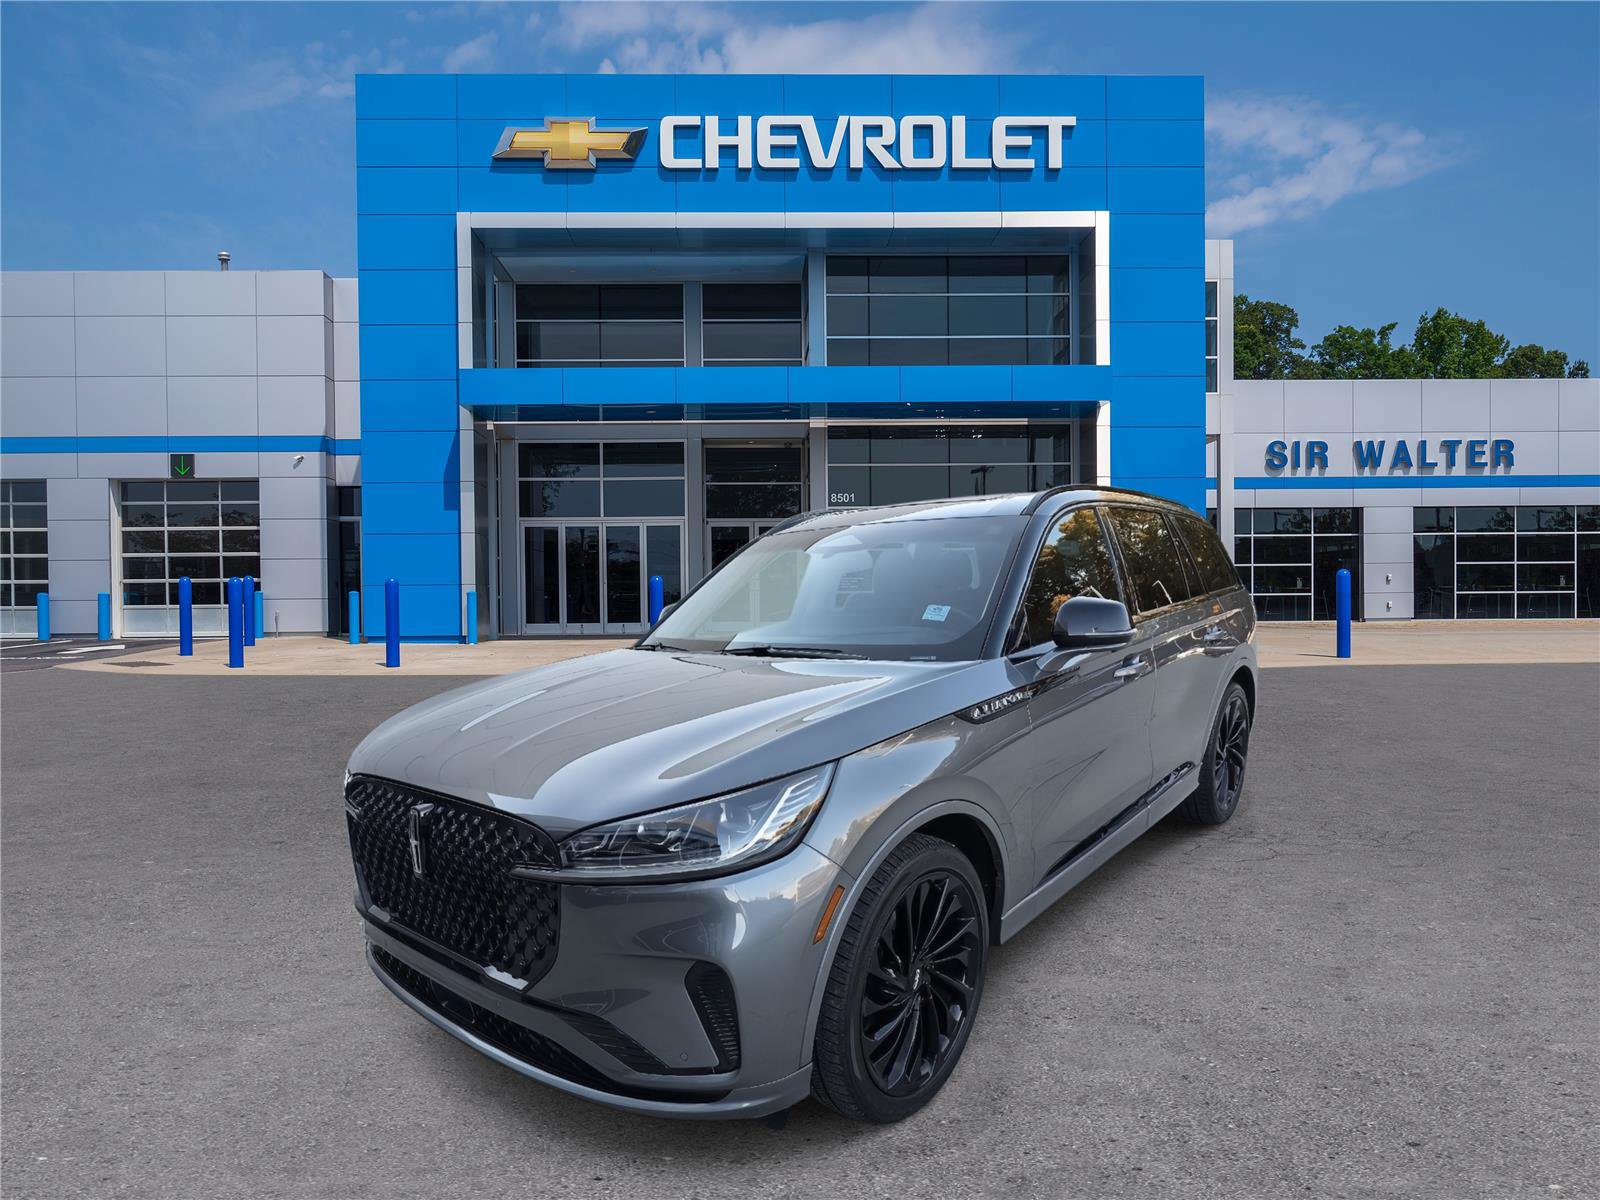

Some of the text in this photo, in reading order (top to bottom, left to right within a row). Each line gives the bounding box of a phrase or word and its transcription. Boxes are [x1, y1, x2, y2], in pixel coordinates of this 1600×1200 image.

[659, 114, 1077, 170] CHEVROLET
[1265, 439, 1515, 470] SIR WALTER
[830, 493, 855, 503] 8501
